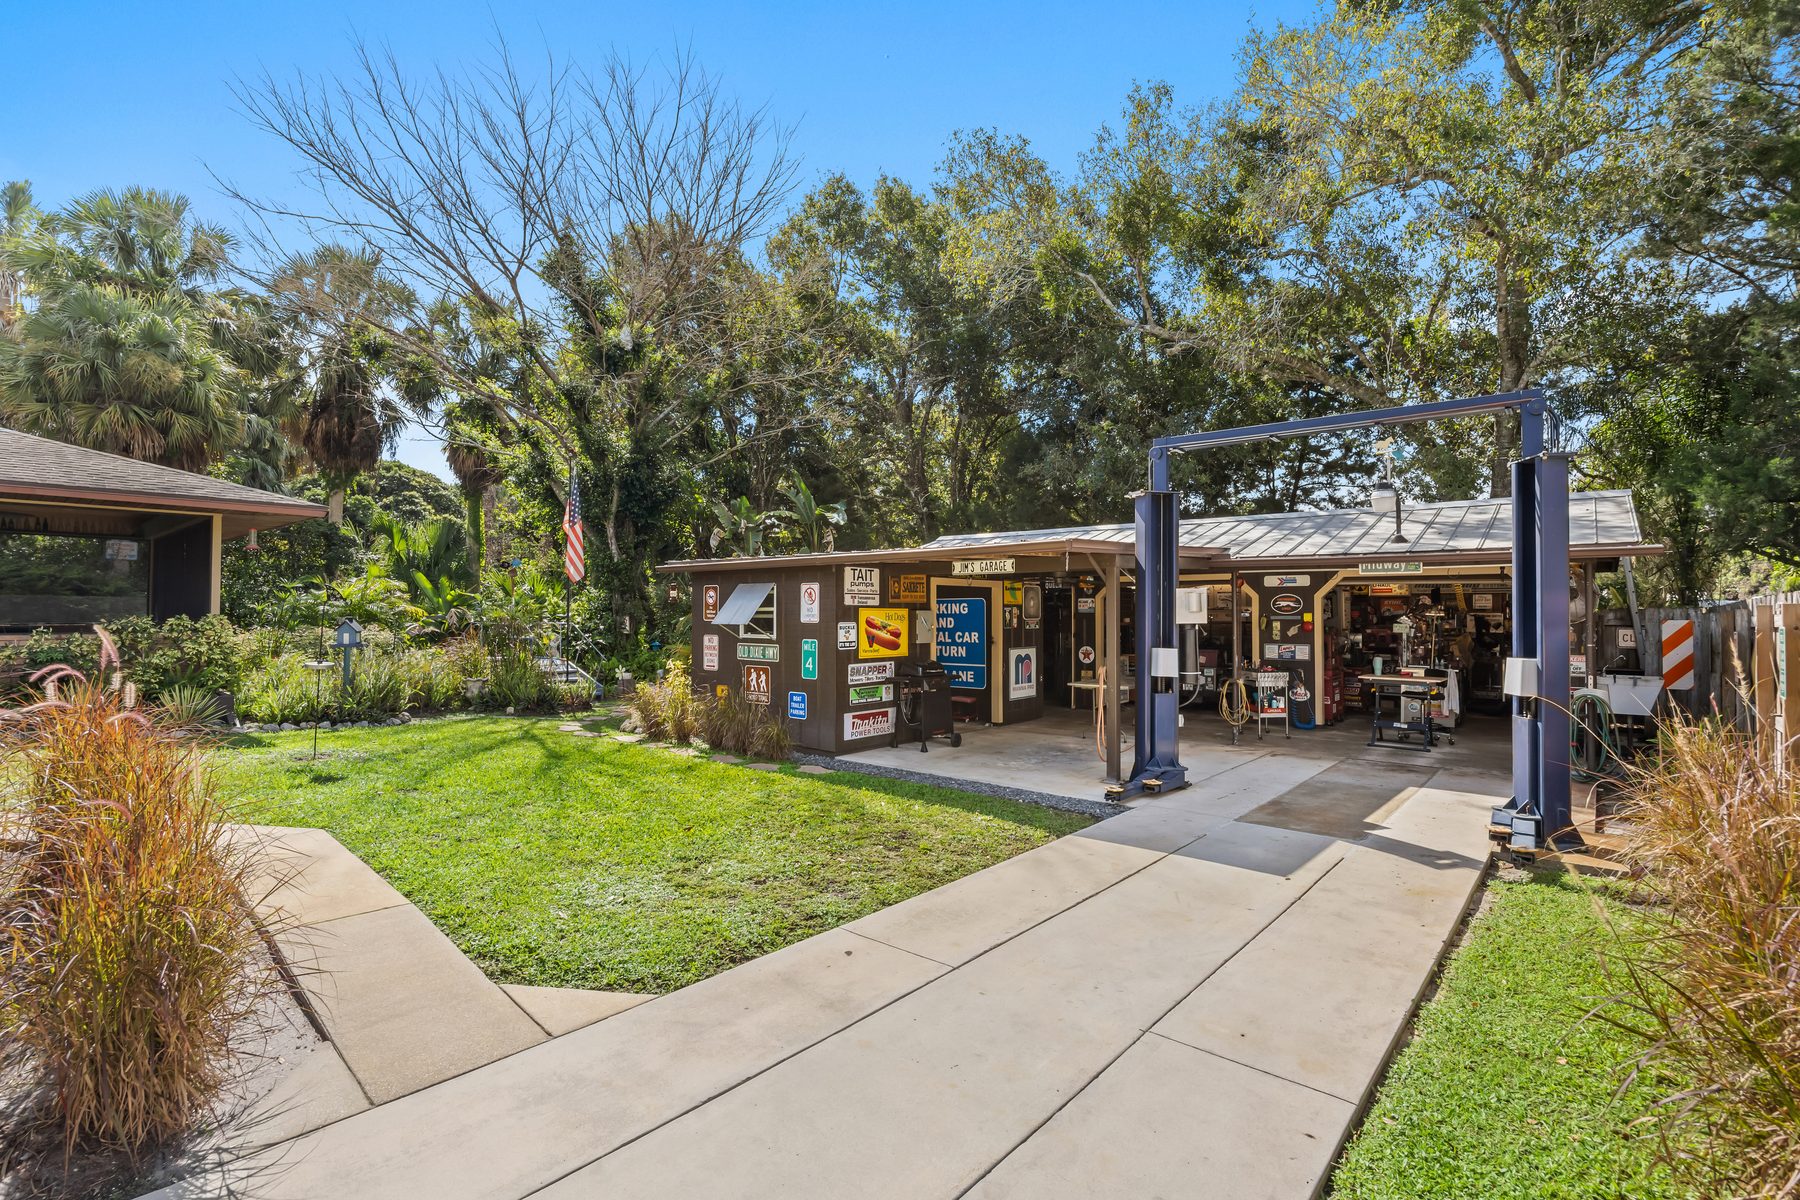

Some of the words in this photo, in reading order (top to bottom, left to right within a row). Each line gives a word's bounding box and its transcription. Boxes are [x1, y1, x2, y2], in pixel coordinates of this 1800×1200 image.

[959, 562, 975, 573] JIM'S
[980, 560, 1008, 572] GARAGE
[850, 568, 875, 582] TAIT
[902, 582, 925, 594] SAKRETE
[885, 613, 894, 621] Hot
[894, 613, 905, 623] Dogs
[955, 632, 979, 643] CAR
[739, 645, 748, 657] OLD
[749, 646, 764, 658] DIXIE
[765, 646, 778, 659] HWY
[803, 643, 815, 651] MILE
[805, 657, 813, 671] 4
[849, 665, 887, 676] SNAPPER
[850, 728, 871, 738] POWER
[873, 725, 891, 734] TOOLS
